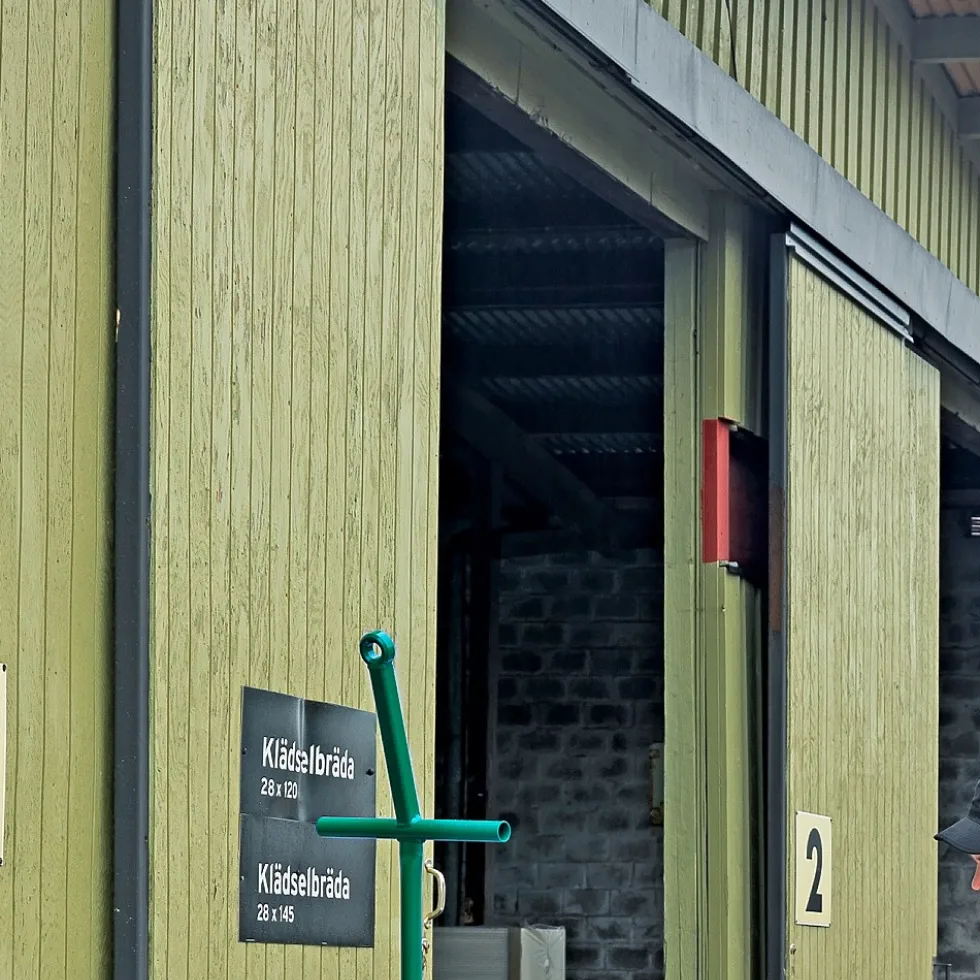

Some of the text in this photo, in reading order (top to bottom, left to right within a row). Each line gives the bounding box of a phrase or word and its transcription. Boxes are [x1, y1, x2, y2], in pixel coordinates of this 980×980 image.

[262, 736, 355, 780] Klädselbräda
[261, 777, 298, 799] 28 x 120
[258, 863, 350, 900] Klädselbräda
[806, 828, 822, 913] 2
[257, 904, 295, 923] 28 x 145
